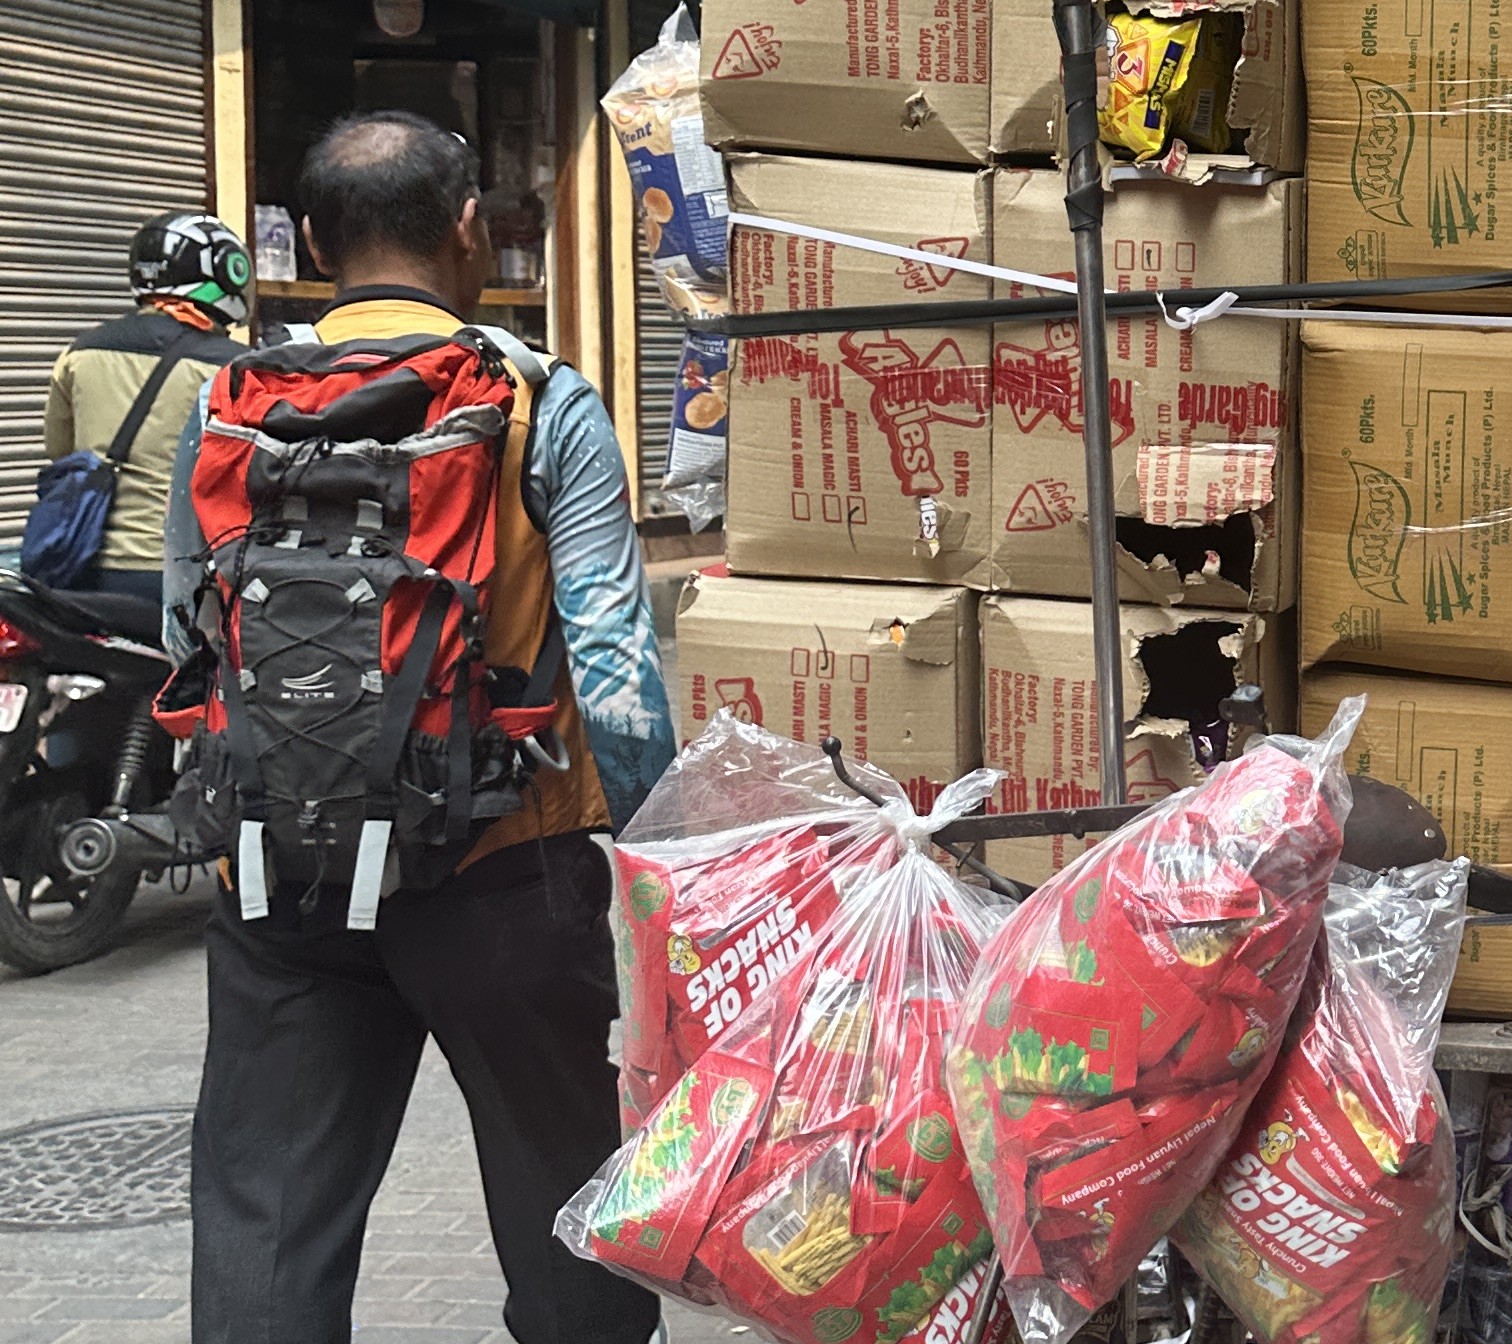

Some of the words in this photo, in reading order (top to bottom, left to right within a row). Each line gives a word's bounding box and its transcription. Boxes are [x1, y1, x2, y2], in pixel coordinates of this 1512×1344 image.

[741, 21, 784, 73] Enjoy!
[916, 26, 933, 82] Factory:
[971, 18, 988, 85] Kathmandu,
[1360, 2, 1378, 57] 60Pkts.
[866, 49, 881, 78] TONG
[1358, 86, 1405, 212] Kurkure
[1359, 393, 1376, 445] 60Pkts.
[1482, 386, 1494, 412] Ltd.
[1482, 414, 1494, 432] (P)
[1442, 413, 1456, 484] Munch
[1481, 433, 1493, 492] Products
[1354, 471, 1398, 590] Kurkure
[1479, 541, 1491, 585] Spices
[1478, 587, 1490, 619] Dugar
[685, 896, 797, 1013] SNACKS
[703, 987, 743, 1039] OF
[1193, 1114, 1217, 1134] Nepal
[1295, 1094, 1332, 1143] Company
[1326, 1142, 1354, 1177] Food
[1060, 1176, 1117, 1207] Company
[1115, 1160, 1147, 1182] Food
[1230, 1152, 1368, 1245] SNACKS
[1249, 1226, 1271, 1247] Tasty
[1255, 1210, 1351, 1269] KING
[1265, 1240, 1308, 1274] Crunchy
